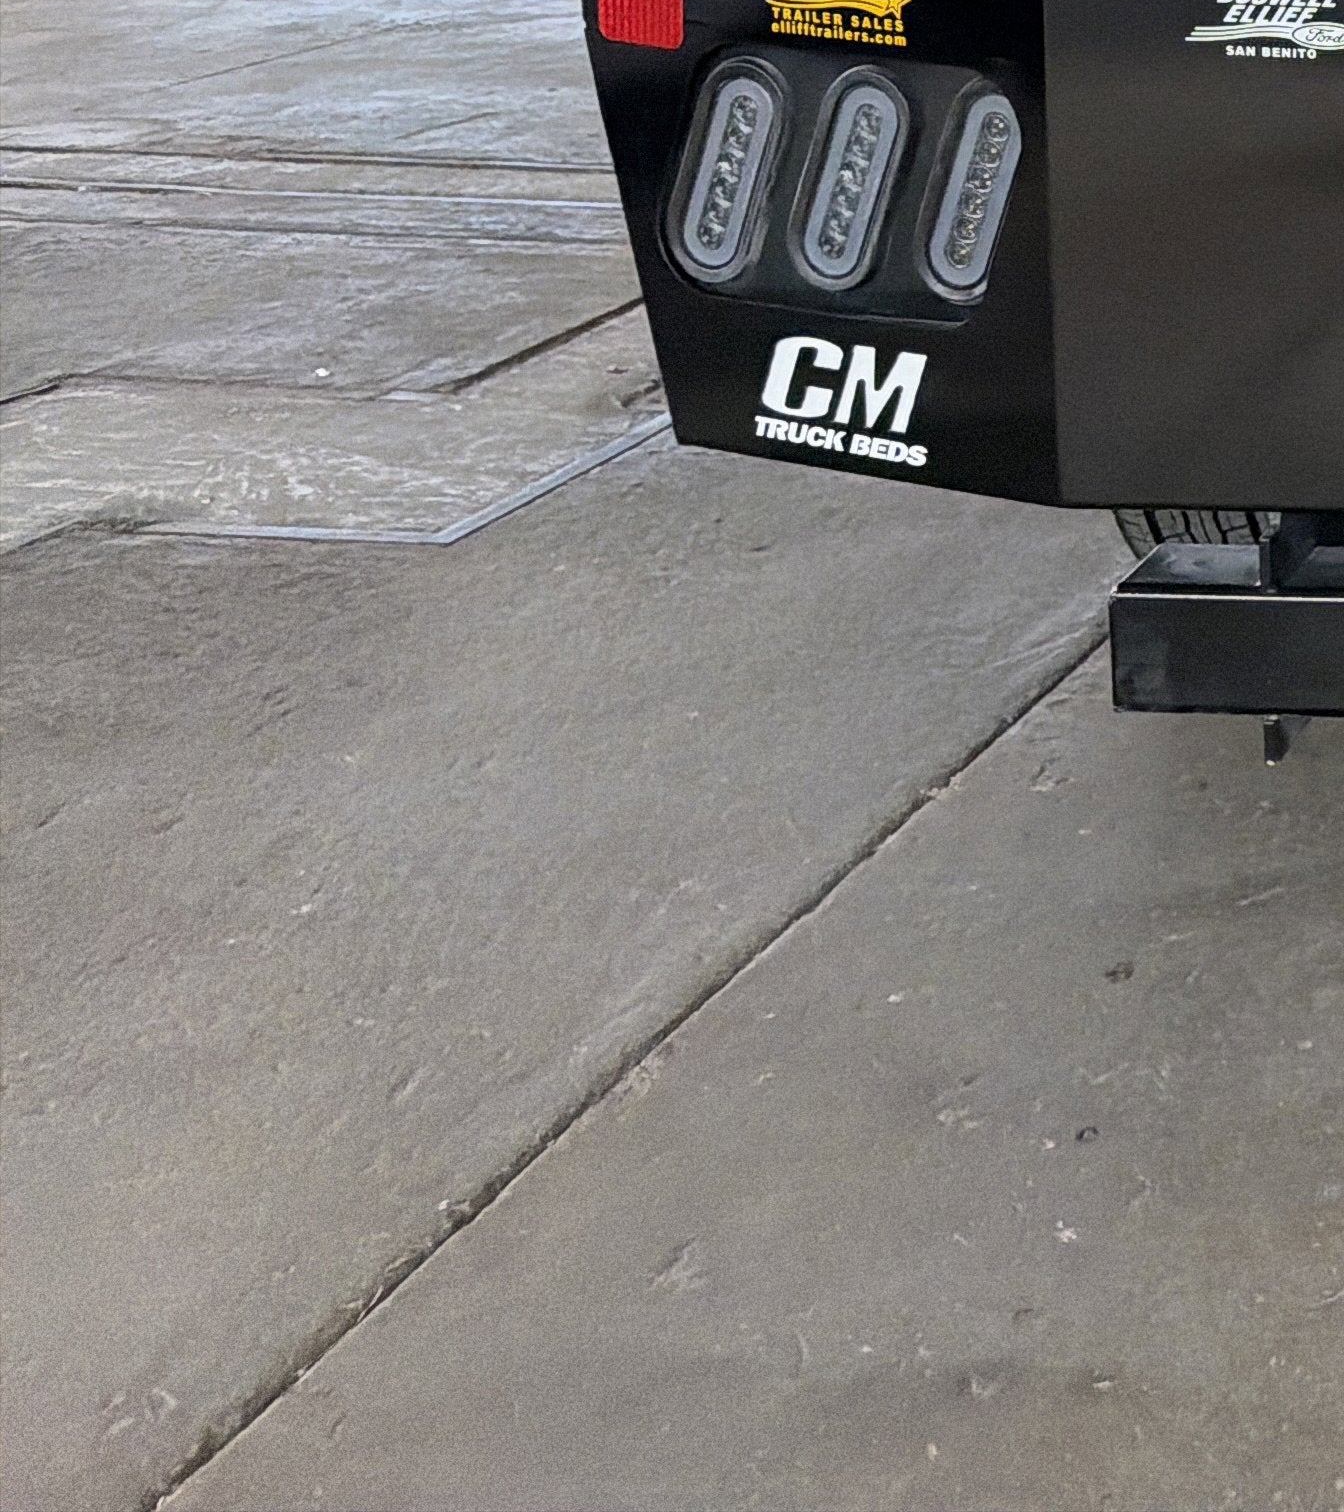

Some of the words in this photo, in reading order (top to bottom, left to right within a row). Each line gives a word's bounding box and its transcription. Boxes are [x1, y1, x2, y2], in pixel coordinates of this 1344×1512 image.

[771, 7, 843, 25] TRAILER
[851, 15, 904, 33] SALES
[1223, 4, 1319, 24] ELLIFF
[771, 21, 907, 46] ellifftrailers.com
[1305, 27, 1344, 43] Ford
[1225, 45, 1256, 57] SAN
[1261, 46, 1317, 59] BENITO
[761, 336, 928, 434] CM
[754, 415, 847, 452] TRUCK
[849, 433, 929, 467] BEDS
